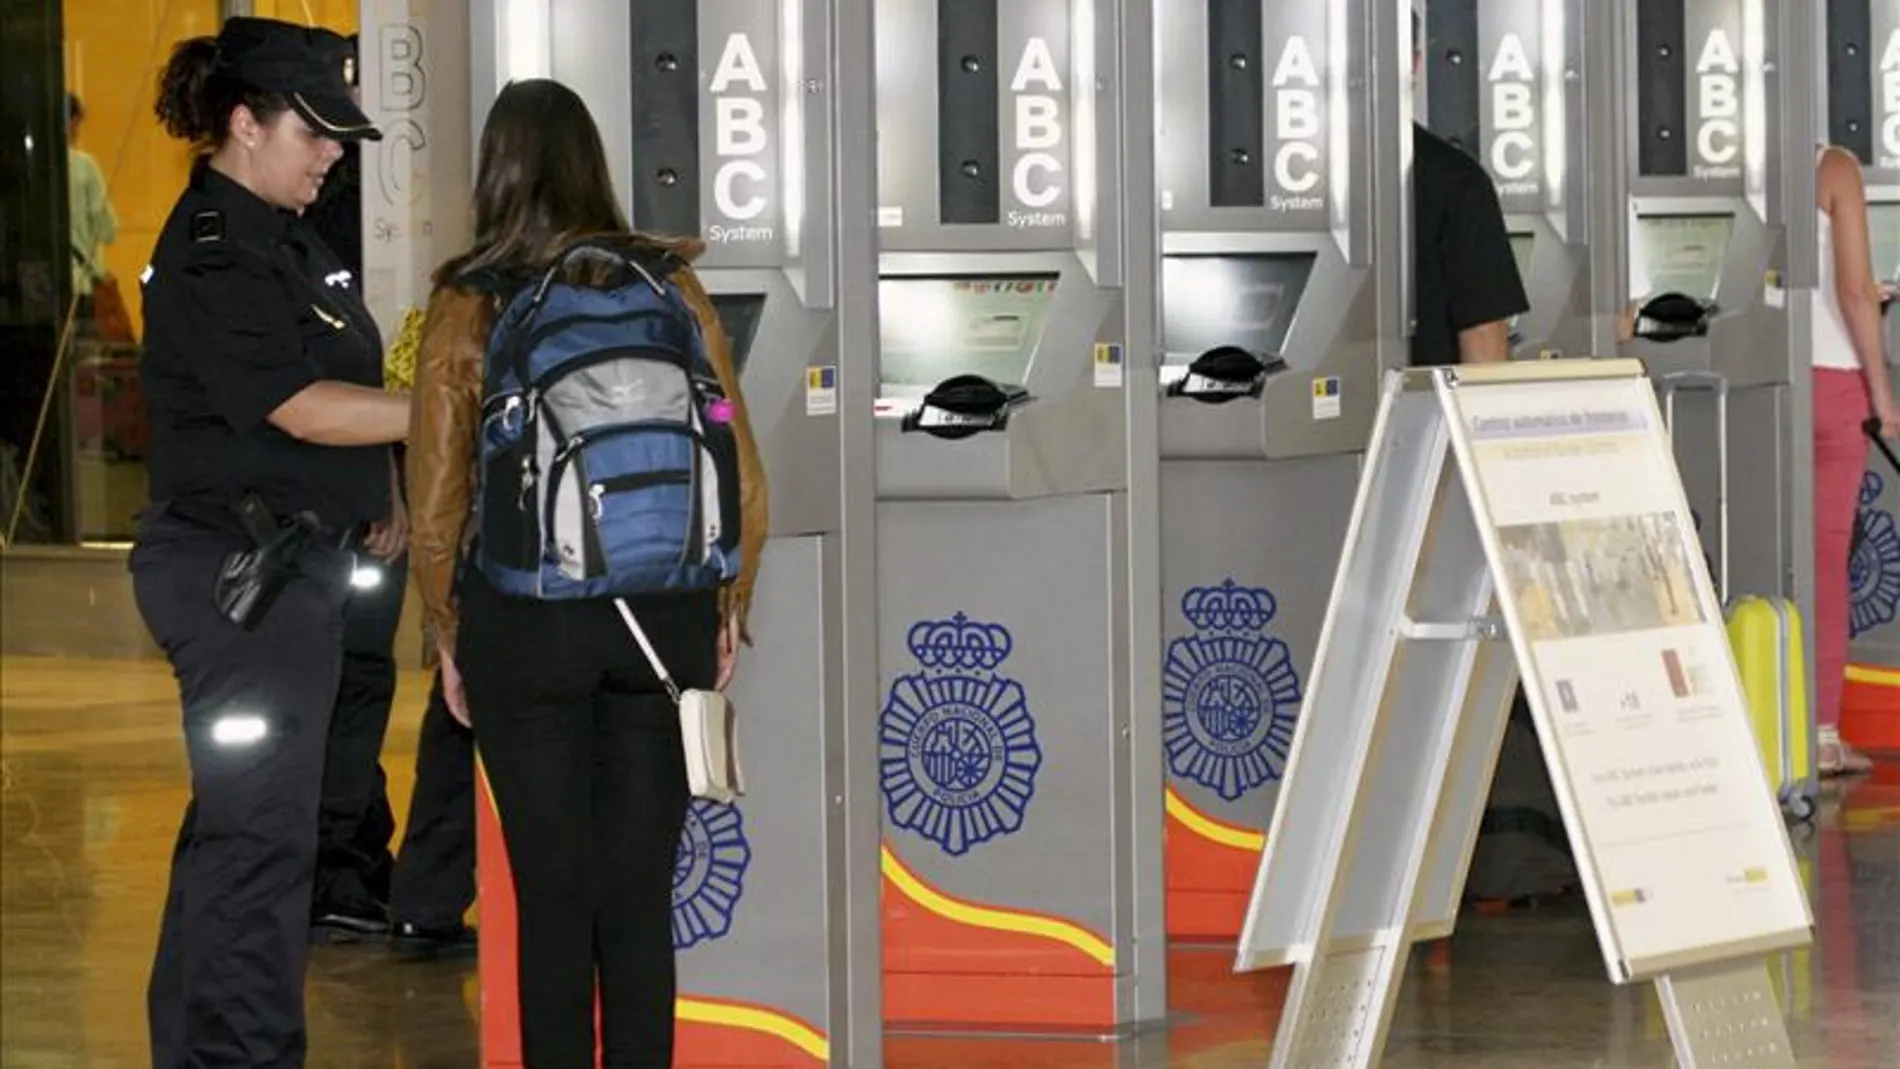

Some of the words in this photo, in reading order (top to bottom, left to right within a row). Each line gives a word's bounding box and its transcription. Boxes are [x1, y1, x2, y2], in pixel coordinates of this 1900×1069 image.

[710, 32, 768, 220] ABC
[1010, 37, 1063, 208] ABC
[1272, 35, 1320, 192] ABC
[1488, 33, 1535, 179] ABC
[1696, 28, 1739, 164] ABC
[709, 223, 774, 243] System
[1007, 210, 1067, 229] System
[1269, 194, 1323, 213] System
